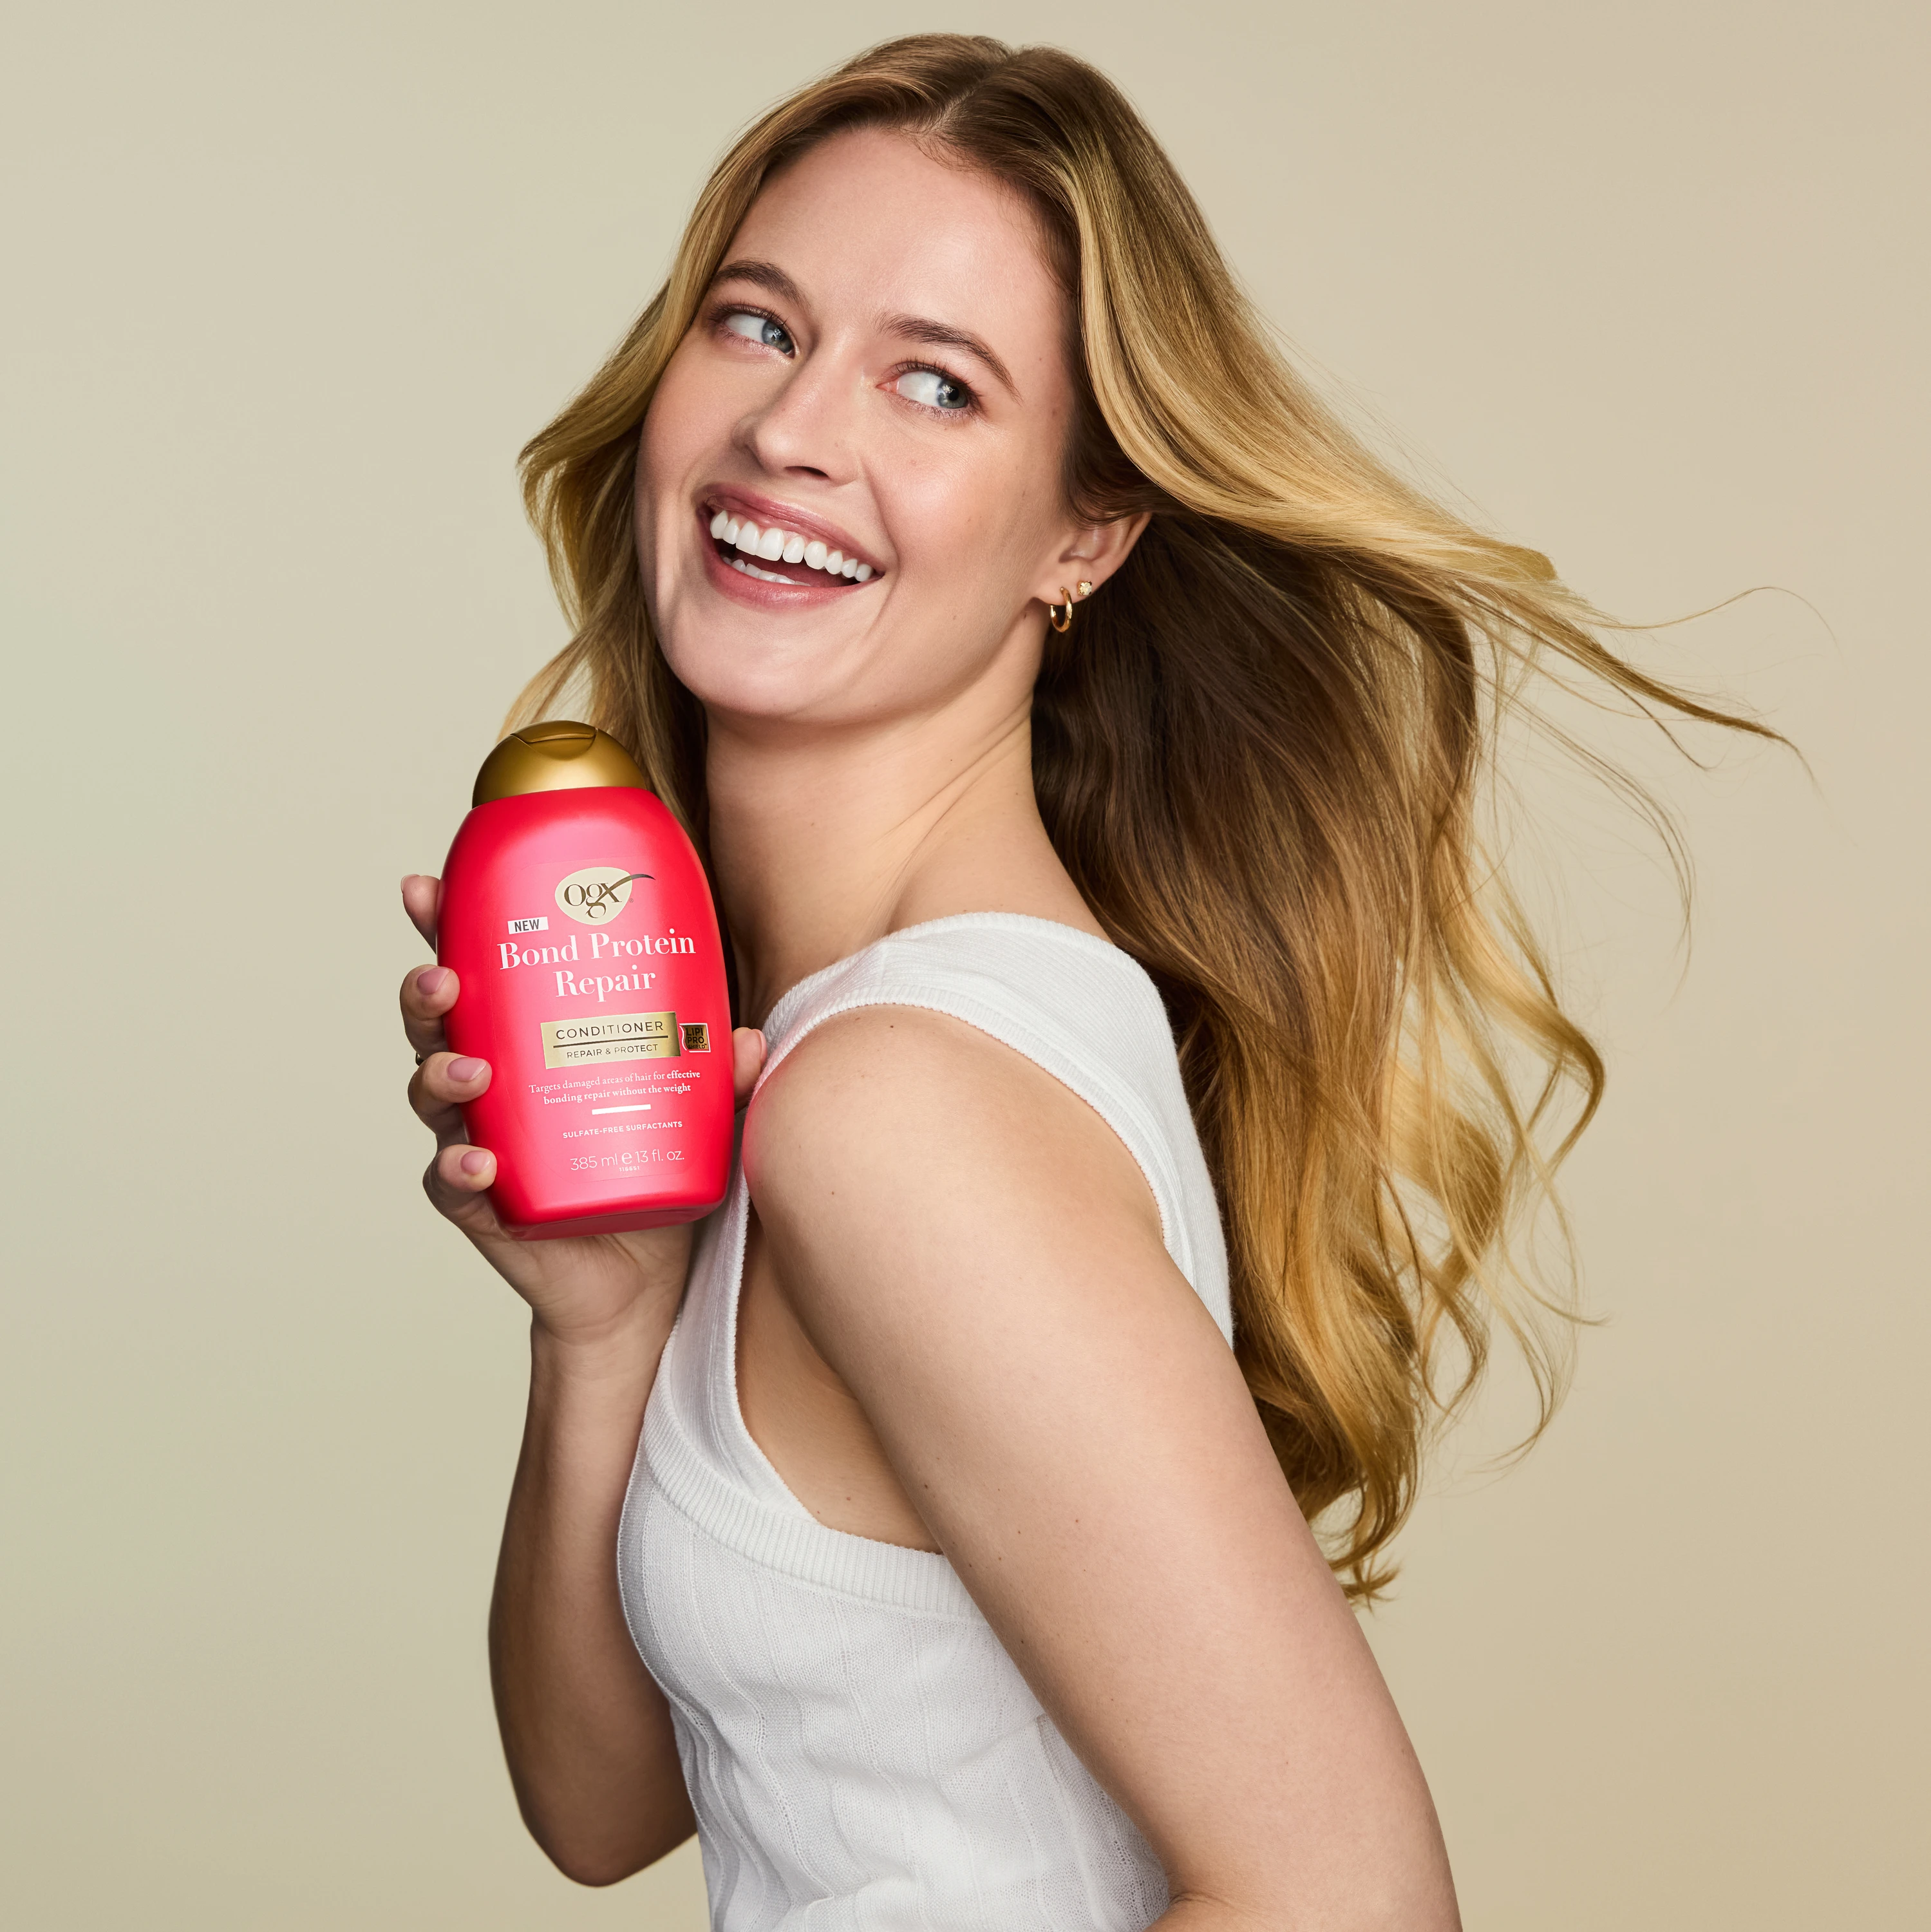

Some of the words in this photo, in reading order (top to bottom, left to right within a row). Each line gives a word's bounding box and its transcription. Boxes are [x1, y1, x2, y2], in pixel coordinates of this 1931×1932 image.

[514, 919, 540, 932] NEW
[497, 936, 579, 970] Bond
[588, 928, 696, 959] Protein
[553, 964, 656, 1002] Repair
[556, 1021, 664, 1040] CONDITIONER
[686, 1028, 703, 1036] LIPI
[567, 1048, 603, 1059] REPAIR
[614, 1044, 658, 1054] PROTECT
[529, 1083, 561, 1094] Targets
[562, 1077, 600, 1089] damaged
[625, 1074, 635, 1082] of
[635, 1073, 652, 1081] hair
[653, 1072, 665, 1080] for
[666, 1070, 701, 1079] effective
[543, 1093, 583, 1104] bonding
[584, 1090, 612, 1101] repair
[612, 1086, 647, 1097] without
[648, 1085, 662, 1094] the
[663, 1083, 691, 1094] weight
[563, 1126, 624, 1139] SULFATE-FREE
[626, 1121, 683, 1132] SURFACTANTS
[570, 1156, 598, 1171] 385
[601, 1153, 618, 1166] ml
[635, 1150, 648, 1163] 13
[652, 1149, 663, 1161] fl.
[666, 1151, 684, 1160] oz.
